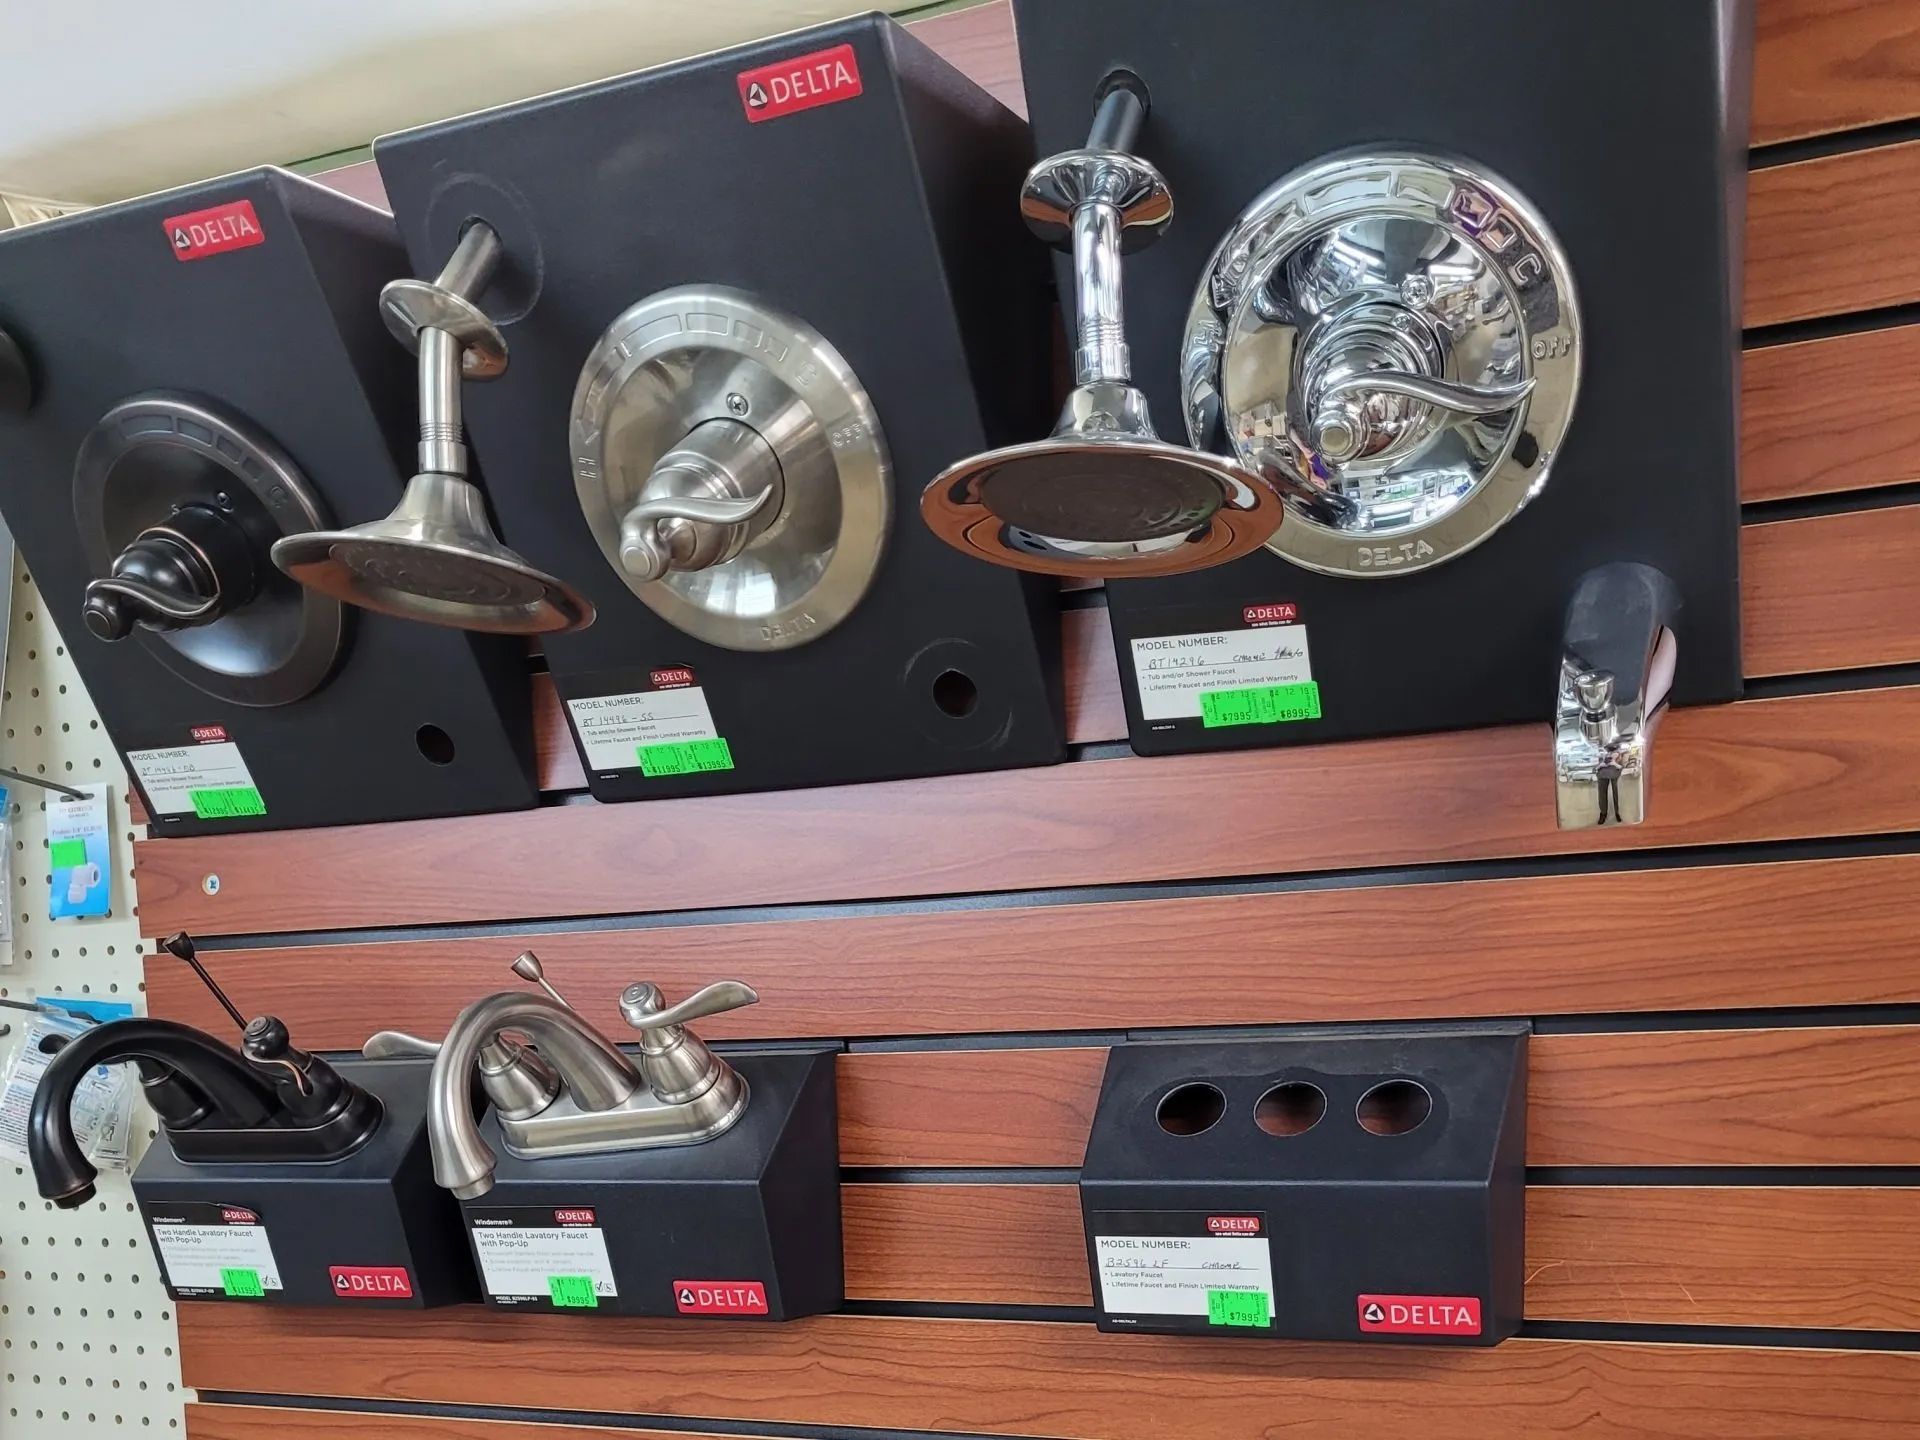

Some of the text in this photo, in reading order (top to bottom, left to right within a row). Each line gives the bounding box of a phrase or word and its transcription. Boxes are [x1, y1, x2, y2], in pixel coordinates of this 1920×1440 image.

[770, 61, 852, 104] DELTA
[189, 214, 256, 247] DELTA
[1533, 336, 1571, 360] OFF
[1358, 540, 1434, 567] DELTA
[1257, 606, 1293, 619] DELTA
[1136, 636, 1228, 651] MODEL NUMBER:
[661, 672, 690, 682] DELTA
[1148, 673, 1161, 681] Tub
[1149, 682, 1177, 691] Lifetime
[1217, 678, 1237, 686] Finish
[1238, 676, 1264, 684] Limited
[1266, 674, 1298, 682] Warranty
[573, 697, 644, 710] MODEL NUMBER:
[1222, 712, 1251, 721] $7995
[1280, 708, 1310, 718] $8995
[200, 728, 225, 738] DELTA
[230, 1211, 255, 1220] DELTA
[566, 1212, 592, 1220] DELTA
[1221, 1220, 1257, 1229] DELTA
[198, 1229, 227, 1238] Lavatory
[526, 1232, 559, 1240] Lavatory
[176, 1236, 202, 1244] Pop-Up
[499, 1240, 528, 1248] Pop-Up
[1101, 1240, 1190, 1249] MODEL NUMBER:
[350, 1275, 407, 1291] DELTA
[698, 1290, 762, 1306] DELTA
[1230, 1312, 1259, 1322] $7995
[1390, 1305, 1473, 1326] DELTA
